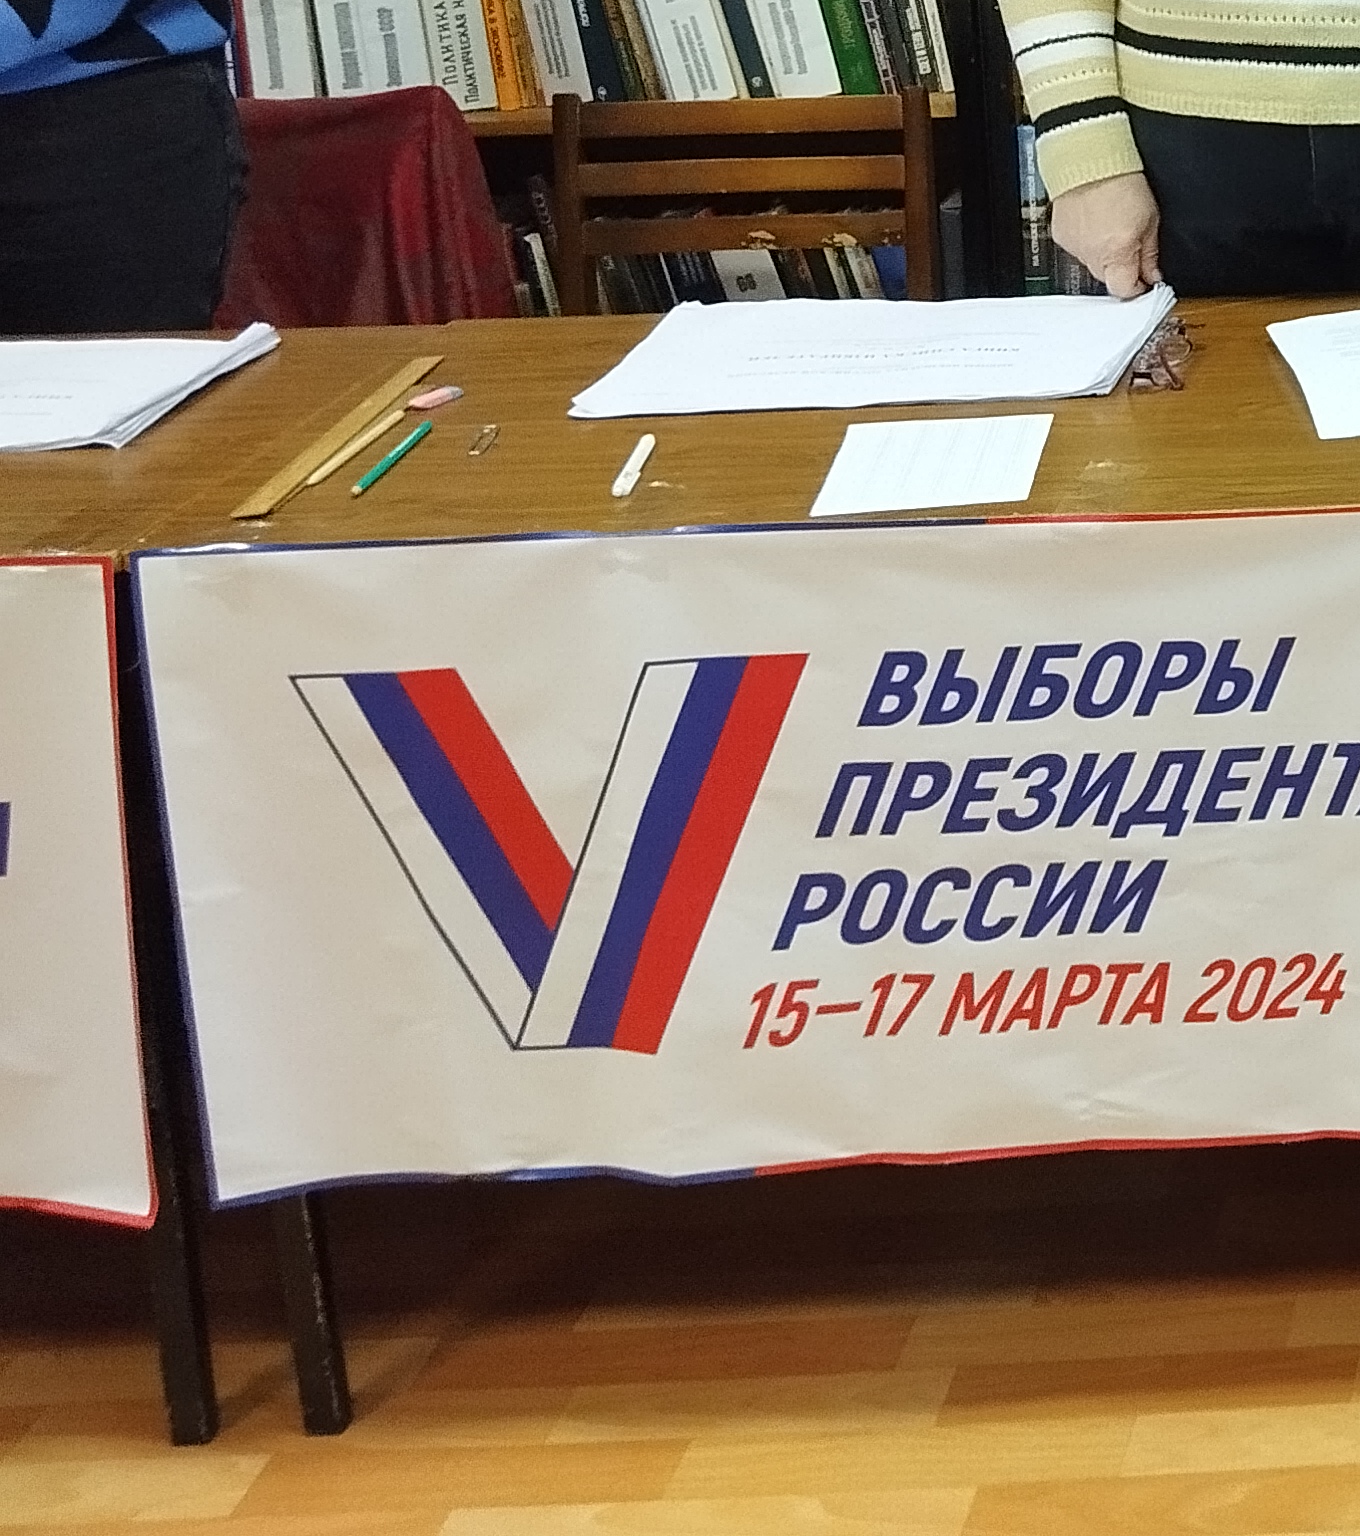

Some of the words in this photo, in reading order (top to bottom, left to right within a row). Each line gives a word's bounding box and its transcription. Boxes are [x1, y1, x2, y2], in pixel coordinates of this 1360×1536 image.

[856, 636, 1297, 727] ВЫБОРЫ
[771, 858, 1168, 951] РОССИИ
[938, 961, 1171, 1037] МАРТА
[1182, 951, 1349, 1024] 2024
